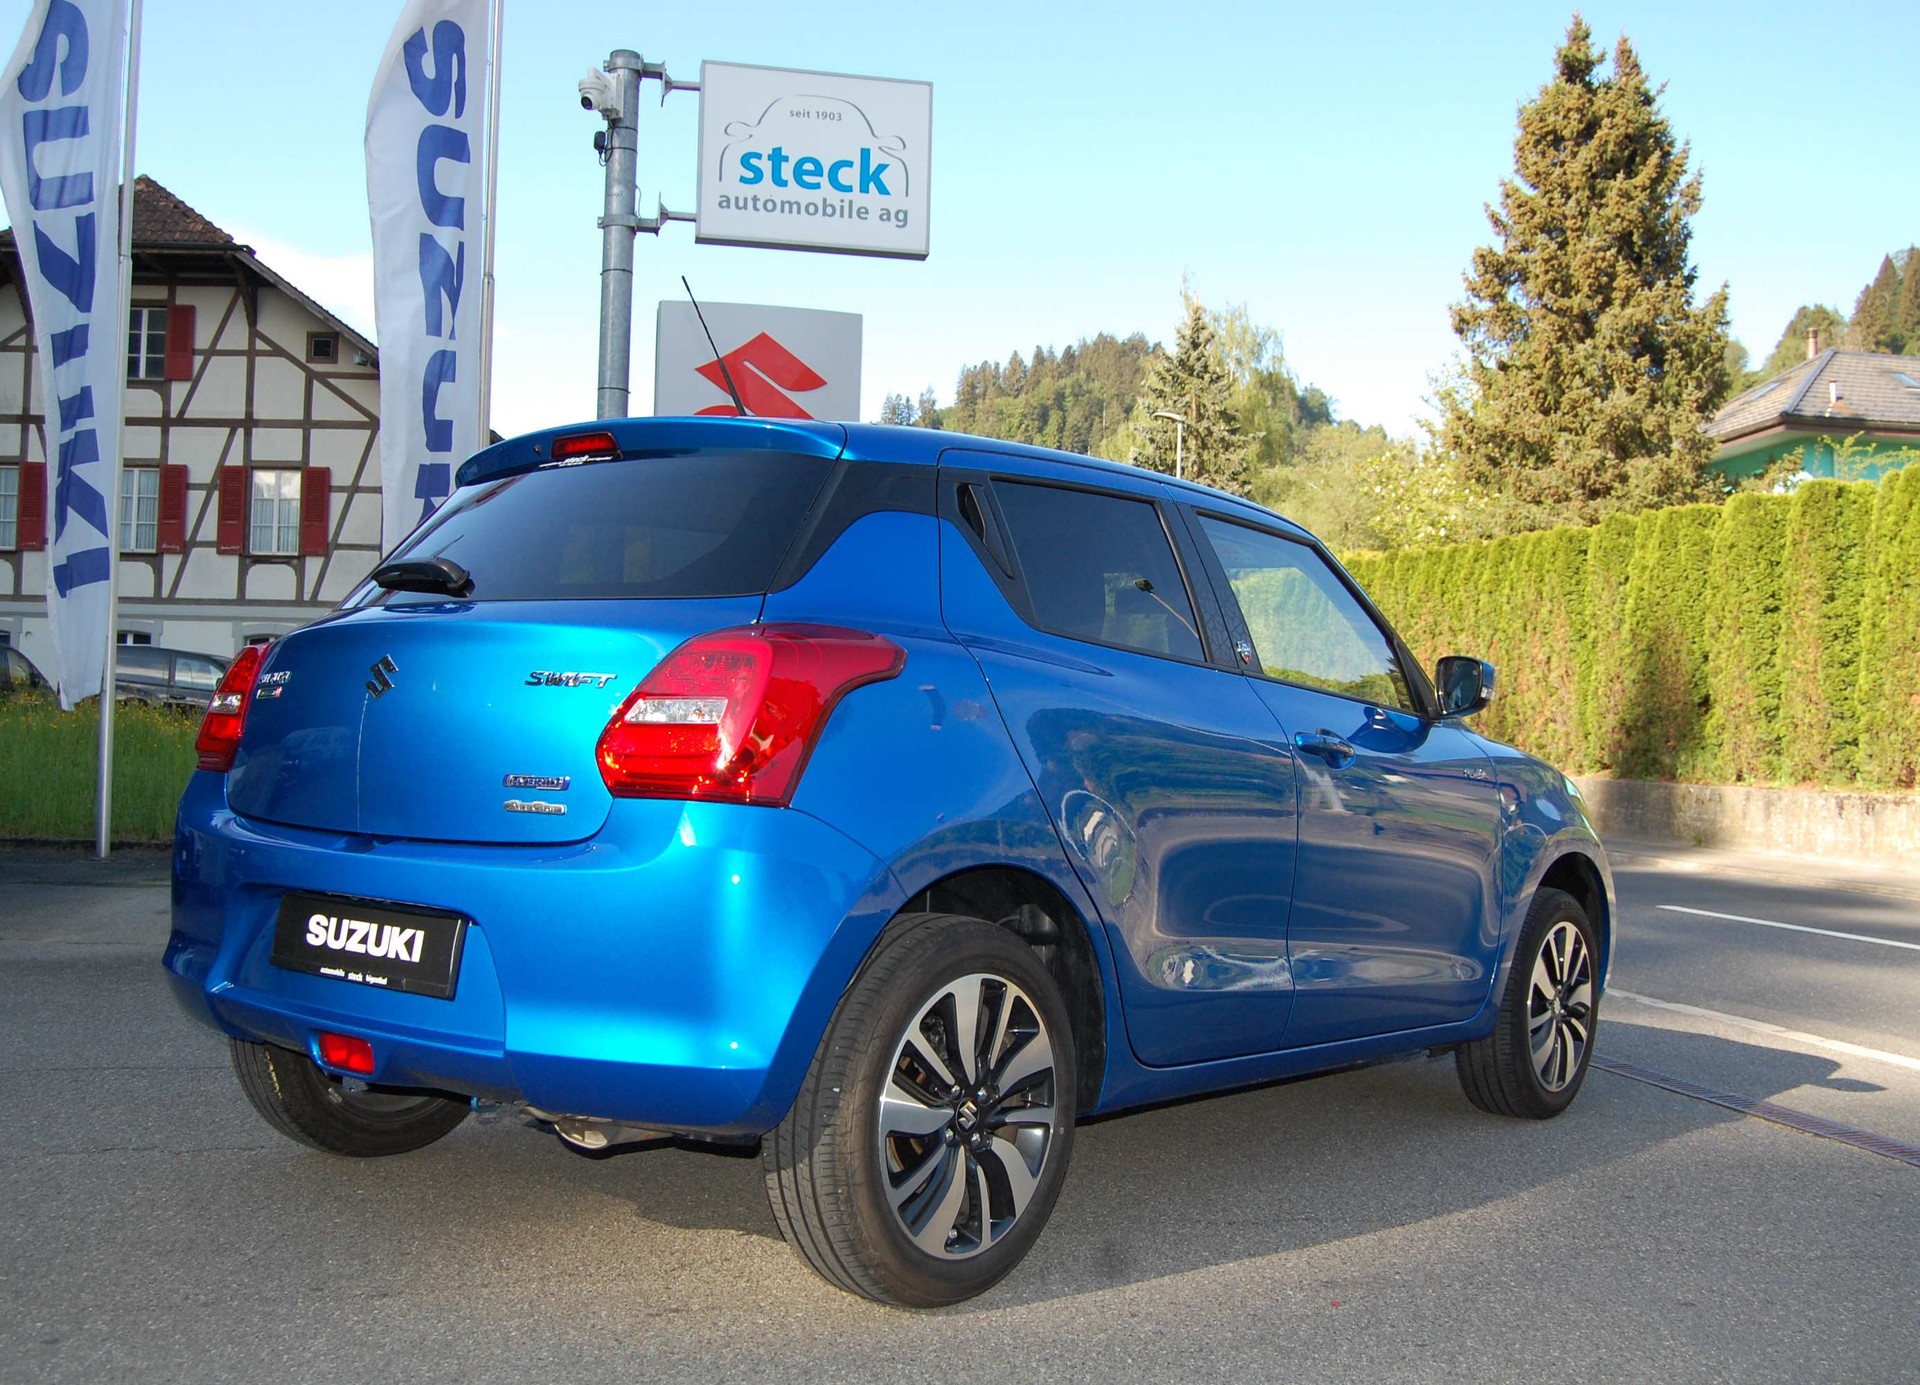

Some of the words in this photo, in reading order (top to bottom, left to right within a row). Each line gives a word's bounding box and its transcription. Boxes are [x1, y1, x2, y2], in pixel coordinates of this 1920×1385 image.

[789, 108, 811, 119] seit
[815, 110, 842, 122] 1903
[738, 146, 892, 196] steck
[718, 193, 869, 221] automobile
[878, 206, 908, 229] ag
[17, 0, 110, 599] SUZUKI
[524, 670, 618, 688] SWIFT
[305, 913, 425, 963] SUZUKI
